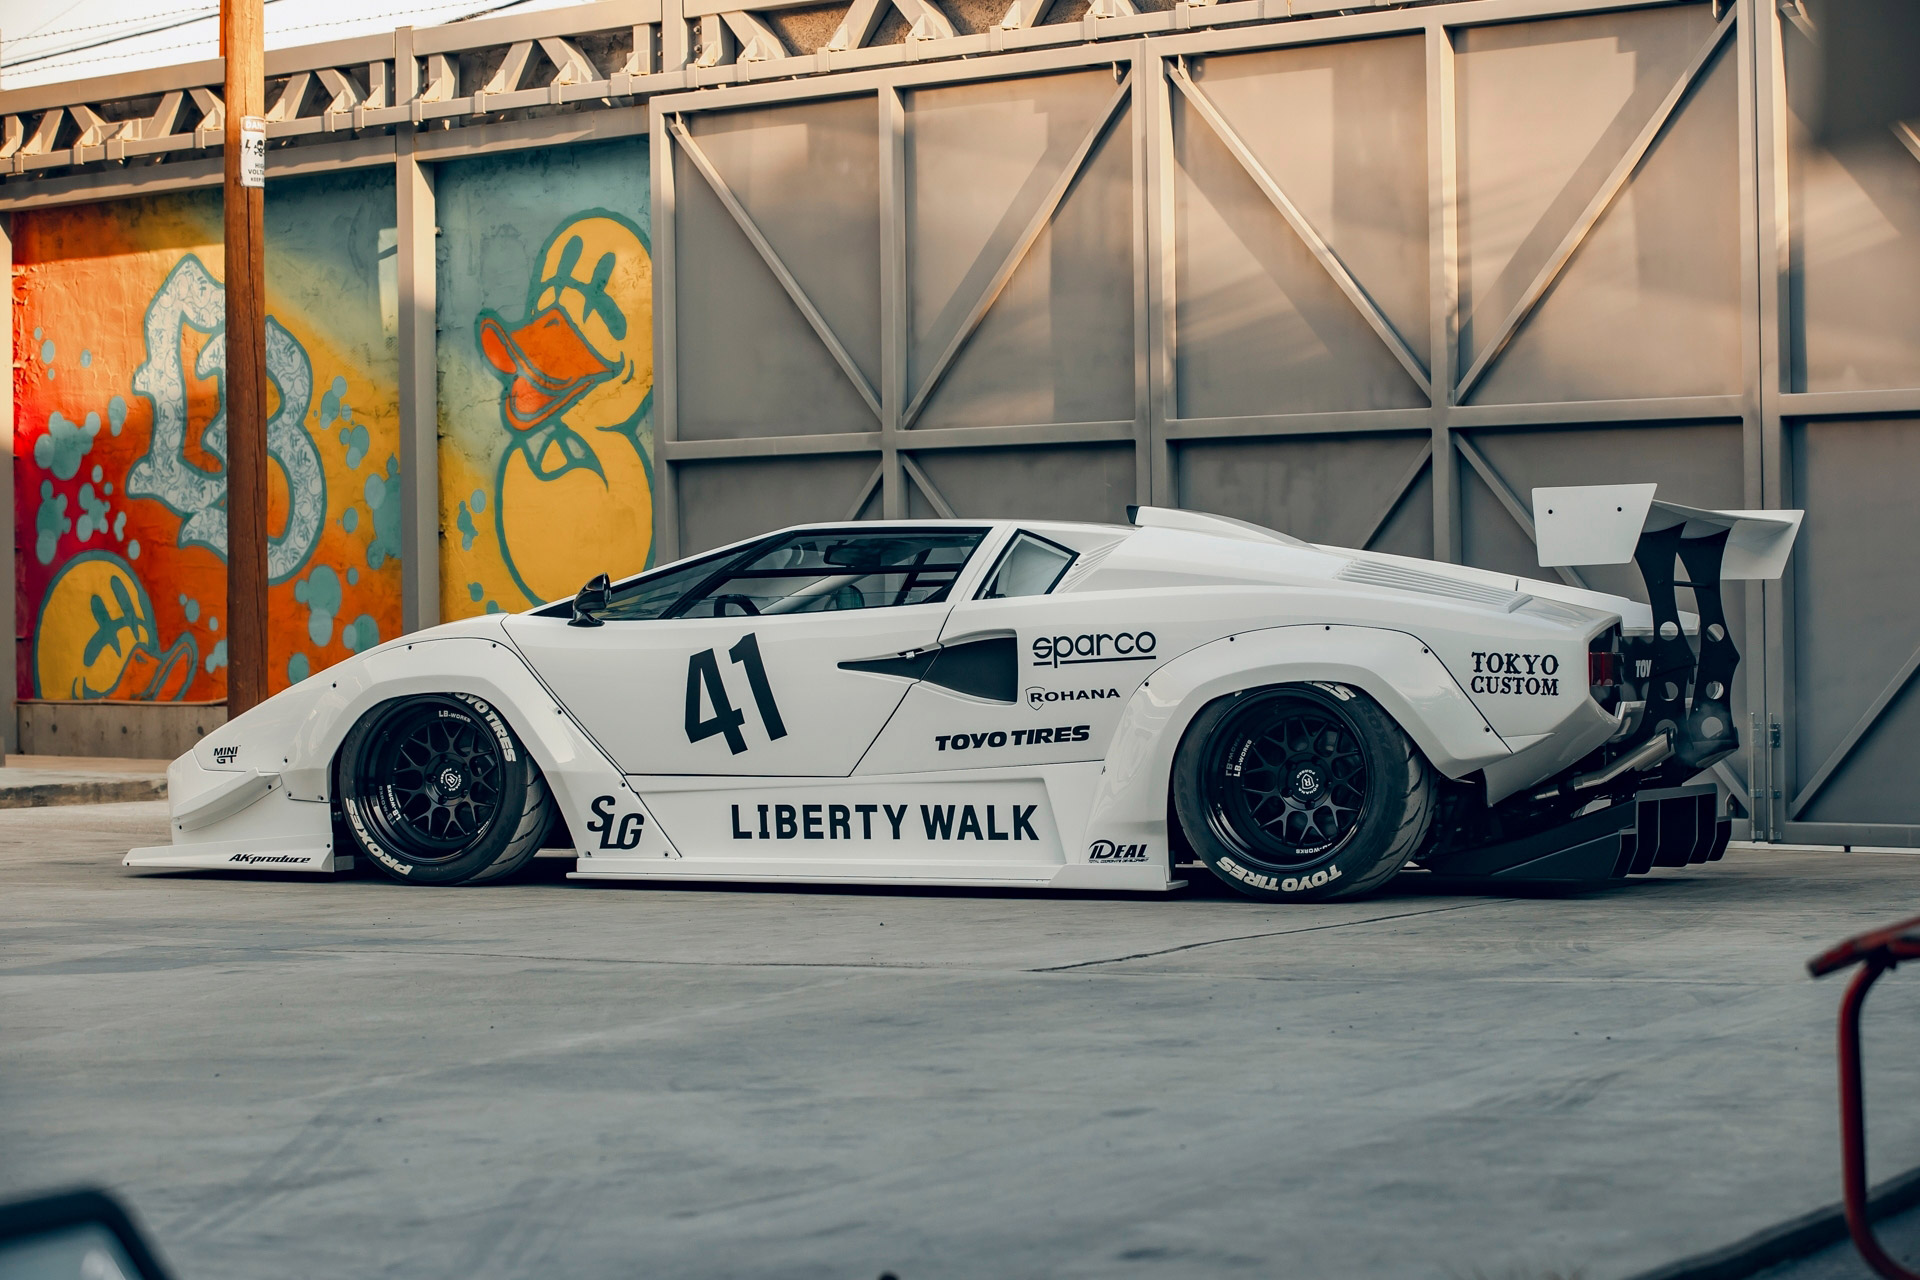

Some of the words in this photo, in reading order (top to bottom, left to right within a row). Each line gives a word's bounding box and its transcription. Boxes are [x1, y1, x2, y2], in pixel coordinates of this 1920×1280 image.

[1032, 631, 1157, 668] sparco
[1471, 651, 1560, 676] TOKYO
[684, 632, 788, 756] 41
[1030, 688, 1121, 702] ROHANA
[1470, 676, 1560, 696] CUSTOM
[485, 710, 517, 762] TIRES
[935, 730, 1008, 751] TOYO
[1011, 725, 1091, 746] TIRES
[213, 746, 239, 756] MINI
[216, 755, 237, 764] GT
[345, 797, 414, 876] PROXES
[586, 795, 645, 850] SLG
[731, 804, 908, 840] LIBERTY
[920, 804, 1040, 841] WALK
[229, 853, 311, 864] AK-produce
[1216, 856, 1279, 891] TIRES
[1281, 864, 1342, 892] TOYO
